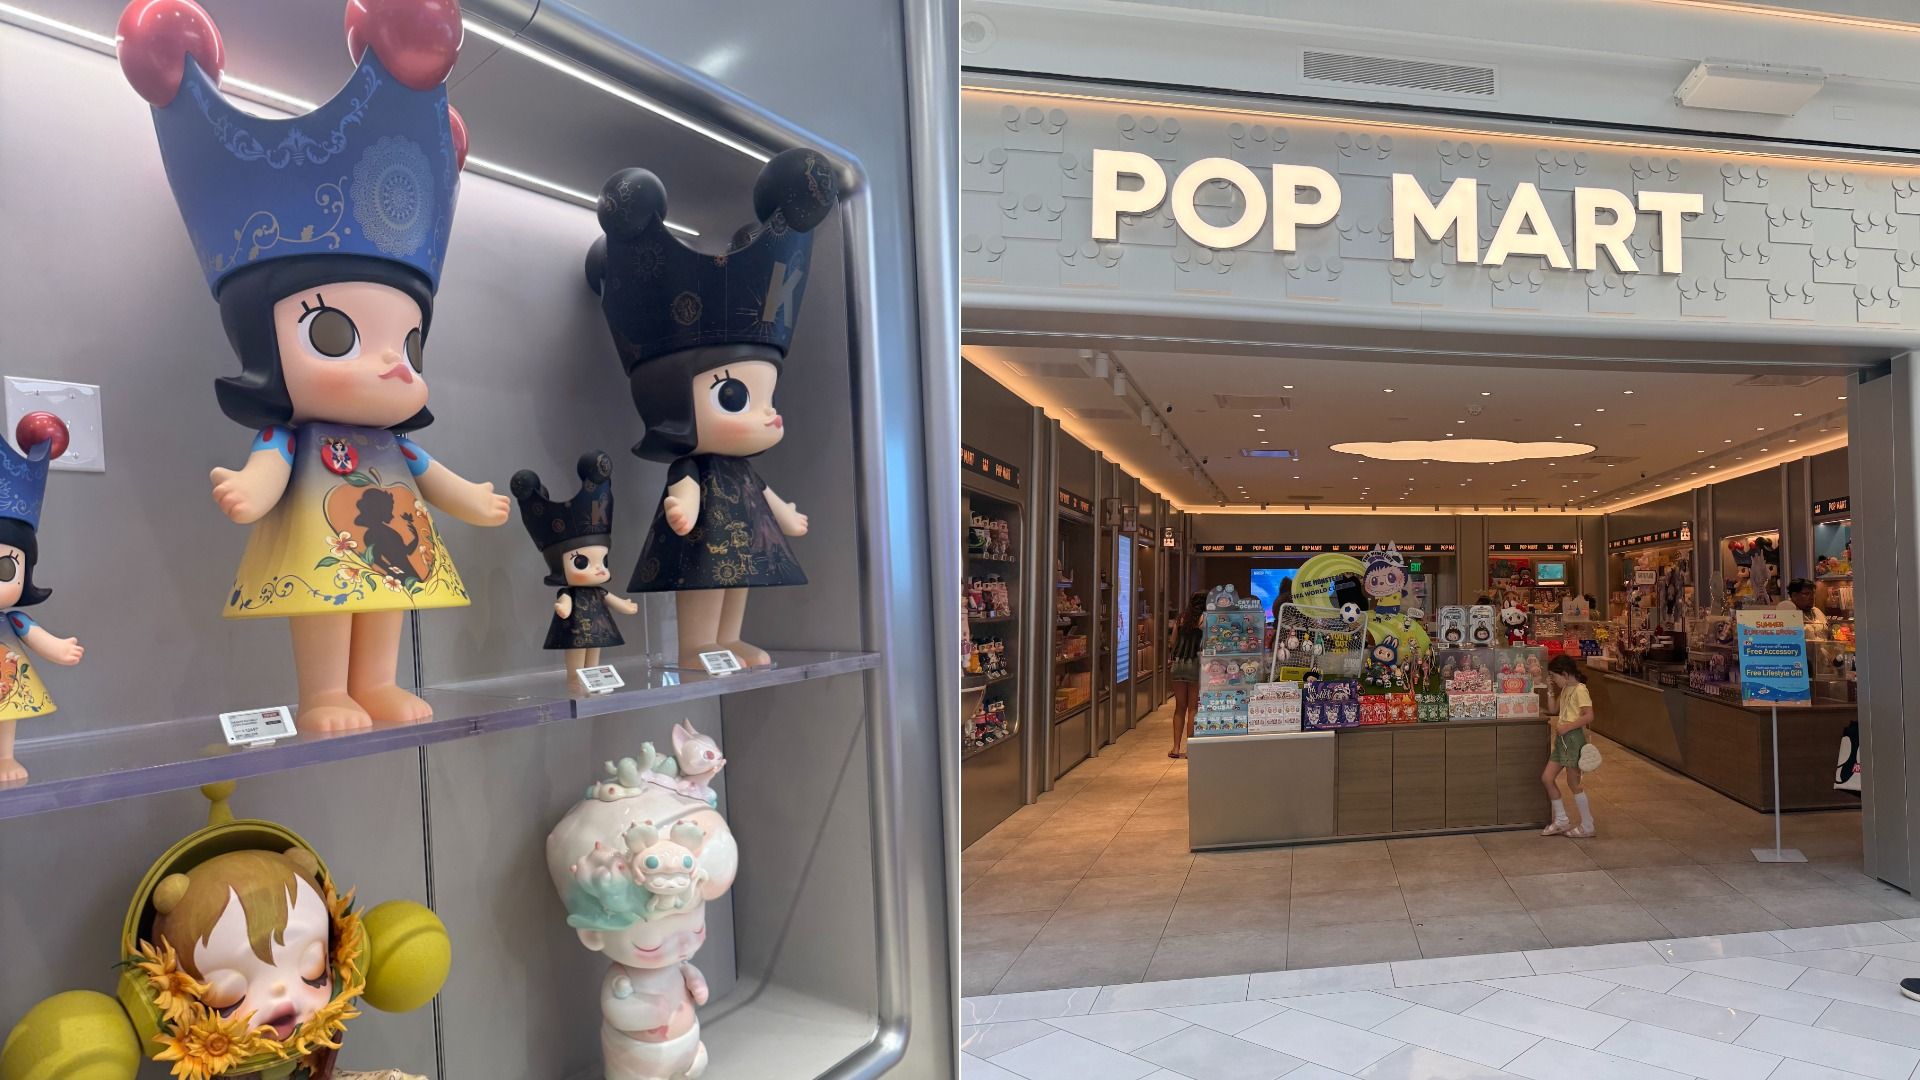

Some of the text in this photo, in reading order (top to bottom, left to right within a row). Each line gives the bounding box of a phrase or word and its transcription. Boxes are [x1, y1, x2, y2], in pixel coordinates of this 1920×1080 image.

[1092, 149, 1704, 274] POP MART
[762, 261, 803, 328] K
[592, 499, 609, 525] K
[1411, 563, 1421, 571] EXIT
[1301, 580, 1313, 588] THE
[1305, 588, 1328, 597] WORLD
[1763, 648, 1798, 656] Accessory
[1762, 669, 1790, 677] Lifestyle
